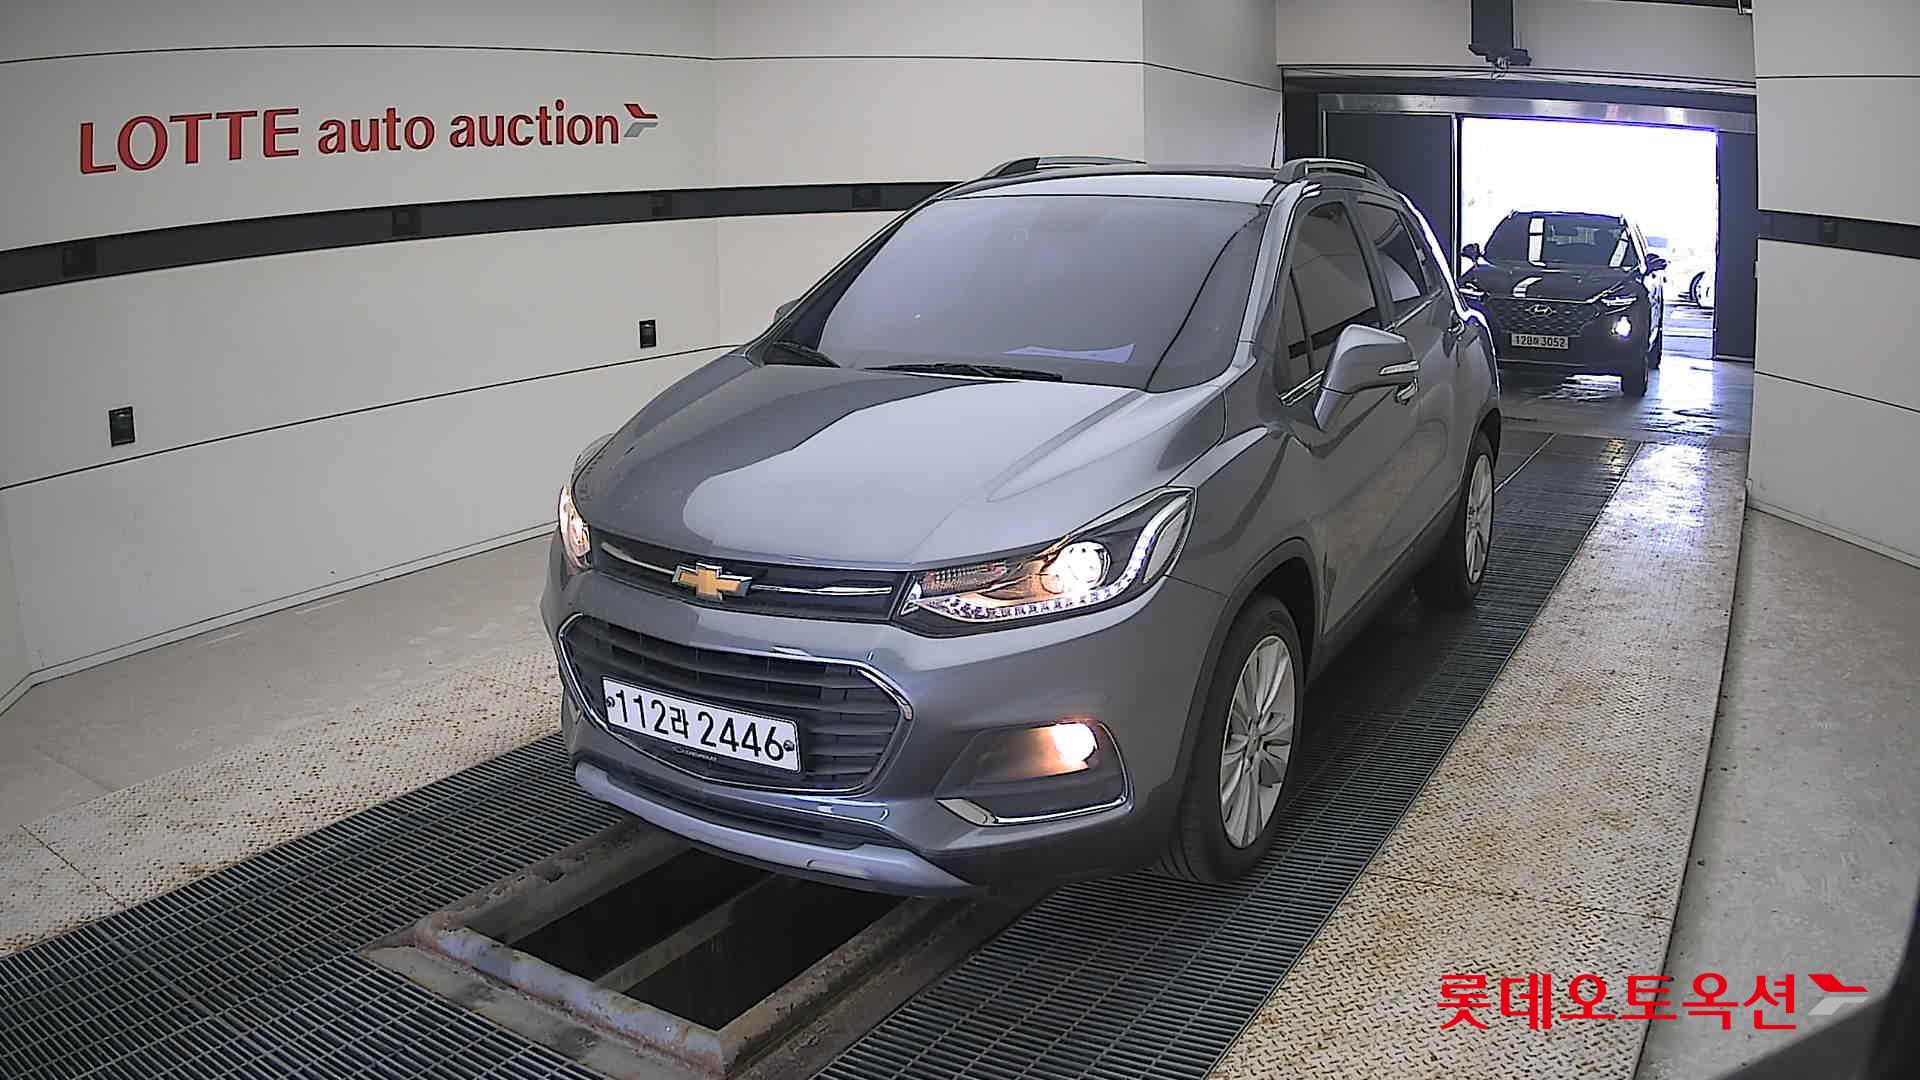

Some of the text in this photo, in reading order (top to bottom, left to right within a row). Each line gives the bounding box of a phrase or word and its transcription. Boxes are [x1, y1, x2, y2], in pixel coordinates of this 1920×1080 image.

[80, 99, 621, 175] LOTTE auto auction
[615, 689, 785, 762] 112라 2446
